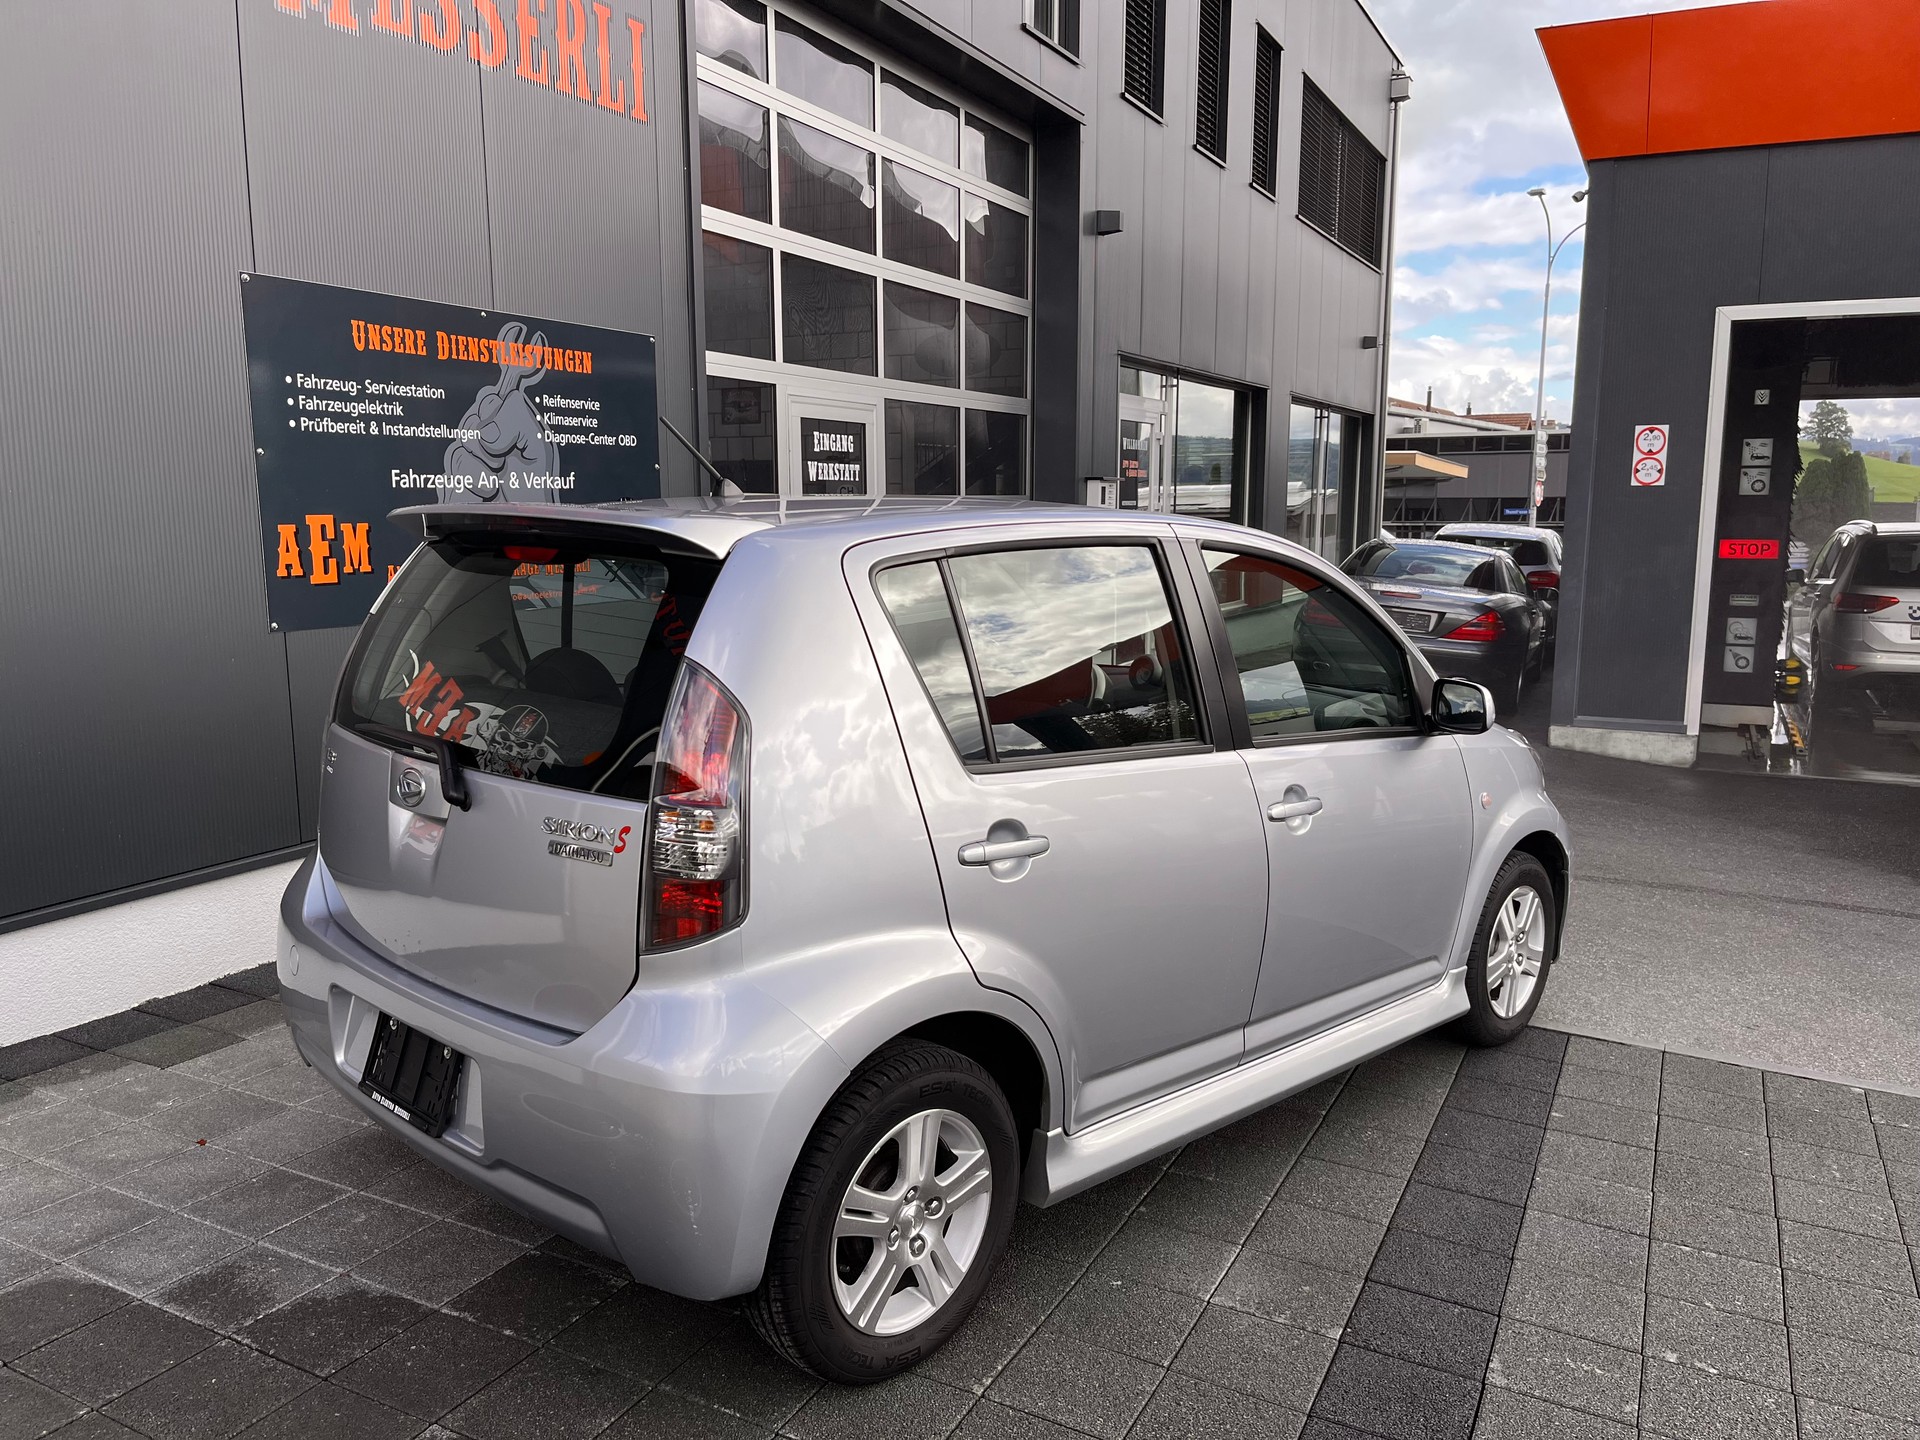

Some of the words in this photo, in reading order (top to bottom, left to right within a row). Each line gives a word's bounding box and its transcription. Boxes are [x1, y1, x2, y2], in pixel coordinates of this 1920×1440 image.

[351, 319, 427, 356] UNSERE
[436, 330, 593, 374] DIENSTLEISTUNGEN
[296, 373, 362, 396] Fahrzeug-
[365, 379, 445, 400] Servicestation
[298, 396, 404, 417] Fahrzeugelektrik
[543, 394, 601, 411] Reifenservice
[300, 417, 366, 436] Prüfbereit
[370, 421, 380, 435] &
[382, 422, 481, 441] Instandstellungen
[544, 412, 598, 428] Klimaservice
[544, 429, 616, 447] Diagnose-Center
[618, 434, 637, 447] OBD
[813, 431, 853, 452] EINGANG
[1643, 433, 1661, 442] 2,90
[807, 461, 860, 482] WERKSTATT
[1641, 463, 1659, 471] 2,45
[391, 468, 474, 494] Fahrzeuge
[477, 472, 505, 490] An-
[508, 472, 521, 489] &
[523, 471, 576, 490] Verkauf
[276, 514, 372, 586] AEM
[1728, 543, 1771, 556] STOP
[541, 816, 617, 847] SIRION
[551, 842, 605, 863] DAIHATSU
